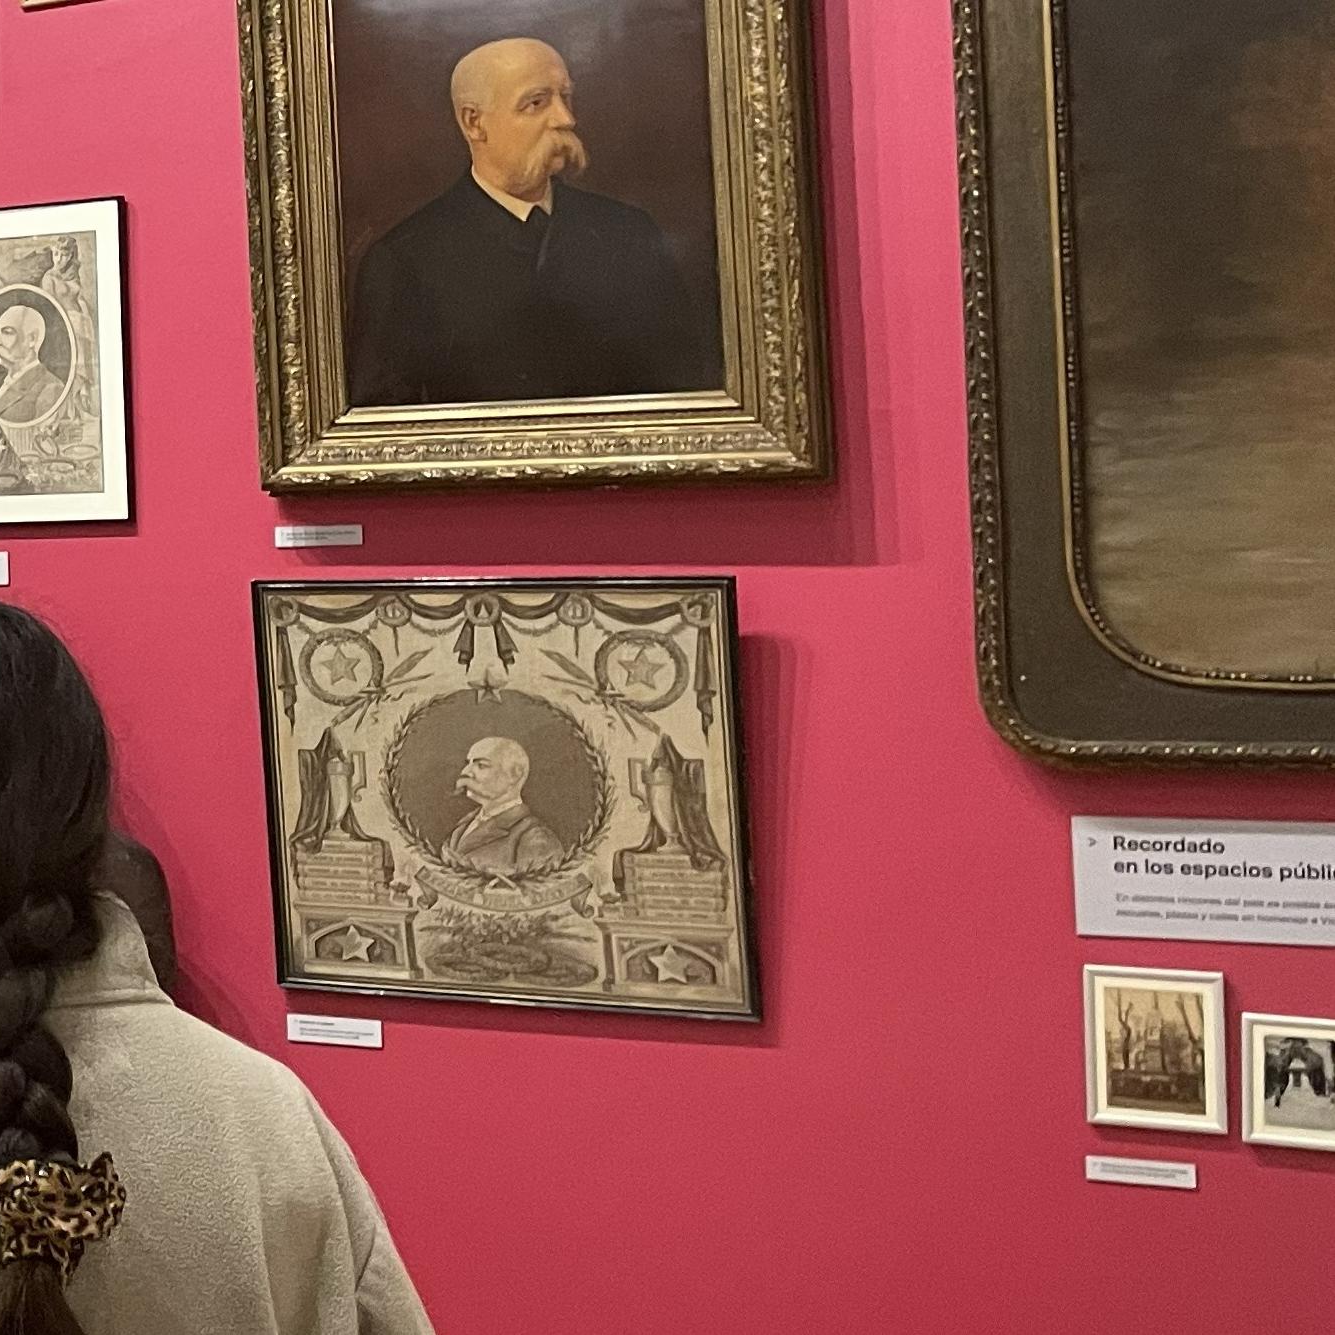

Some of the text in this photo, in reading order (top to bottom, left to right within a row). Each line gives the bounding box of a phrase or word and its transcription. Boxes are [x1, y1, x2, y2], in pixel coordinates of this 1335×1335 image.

[1112, 835, 1226, 855] Recordado
[1114, 858, 1335, 883] en los espacios públi
